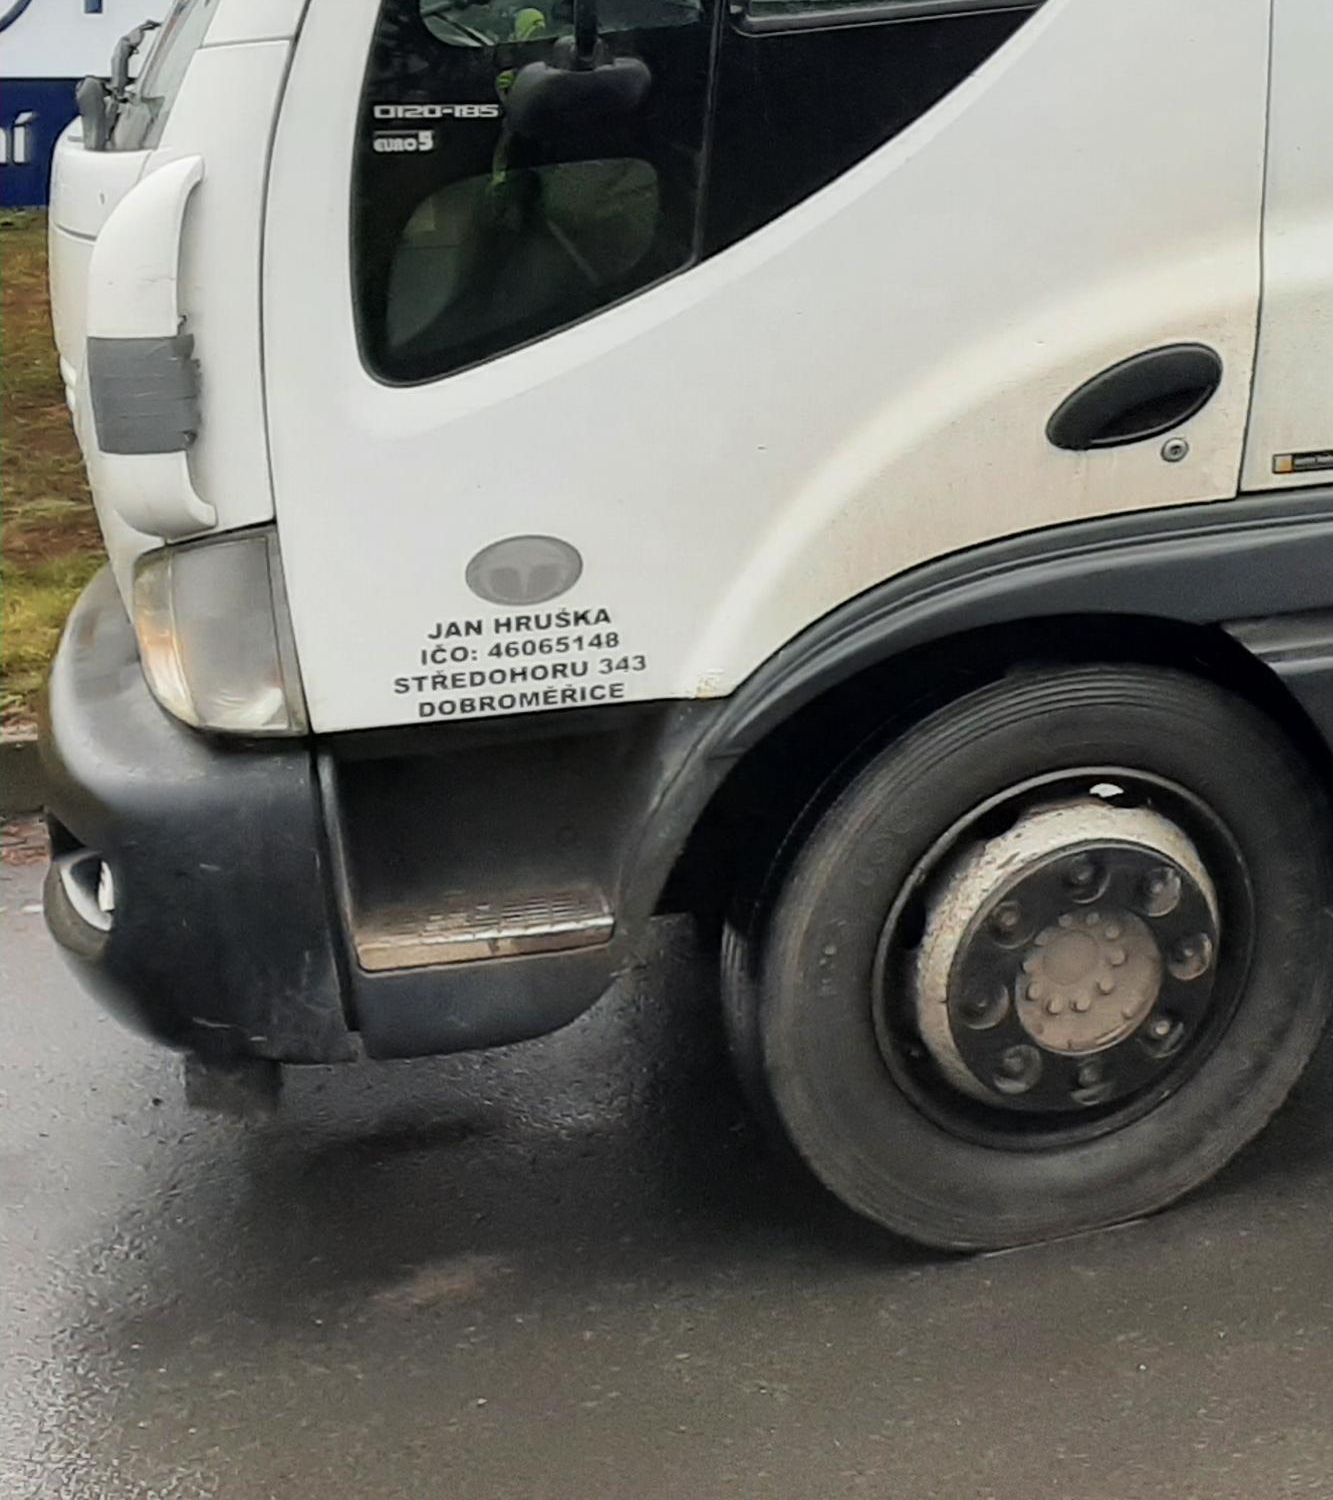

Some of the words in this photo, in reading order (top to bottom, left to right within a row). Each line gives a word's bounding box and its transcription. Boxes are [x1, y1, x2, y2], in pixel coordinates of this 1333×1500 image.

[427, 619, 484, 640] JAN
[493, 607, 612, 635] HRUŠKA
[420, 644, 478, 666] IČO:
[487, 631, 620, 660] 46065148
[393, 660, 589, 694] STŘEDOHORU
[598, 654, 647, 675] 343
[418, 682, 626, 718] DOBROMĚŘICE
